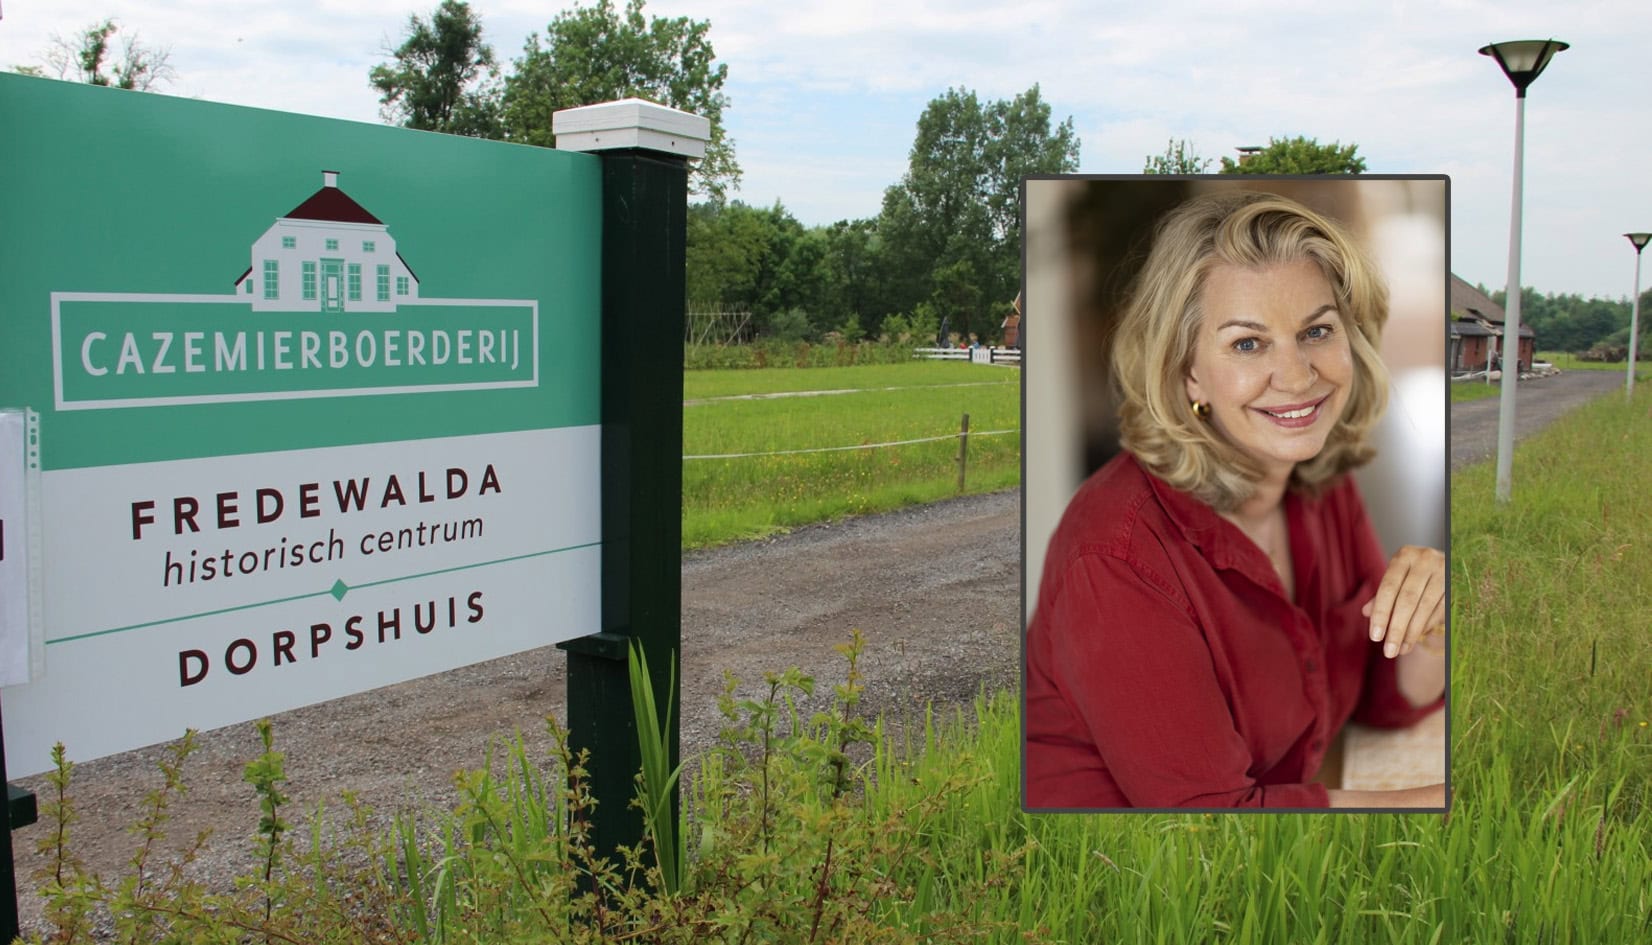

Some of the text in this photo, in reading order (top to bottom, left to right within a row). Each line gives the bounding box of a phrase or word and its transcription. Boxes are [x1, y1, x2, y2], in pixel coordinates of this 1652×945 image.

[80, 328, 521, 377] CAZEMIERBOERDERIJ
[131, 463, 503, 540] FREDEWALDA
[163, 516, 484, 587] historisch centrum
[178, 590, 485, 687] DORPSHUIS
